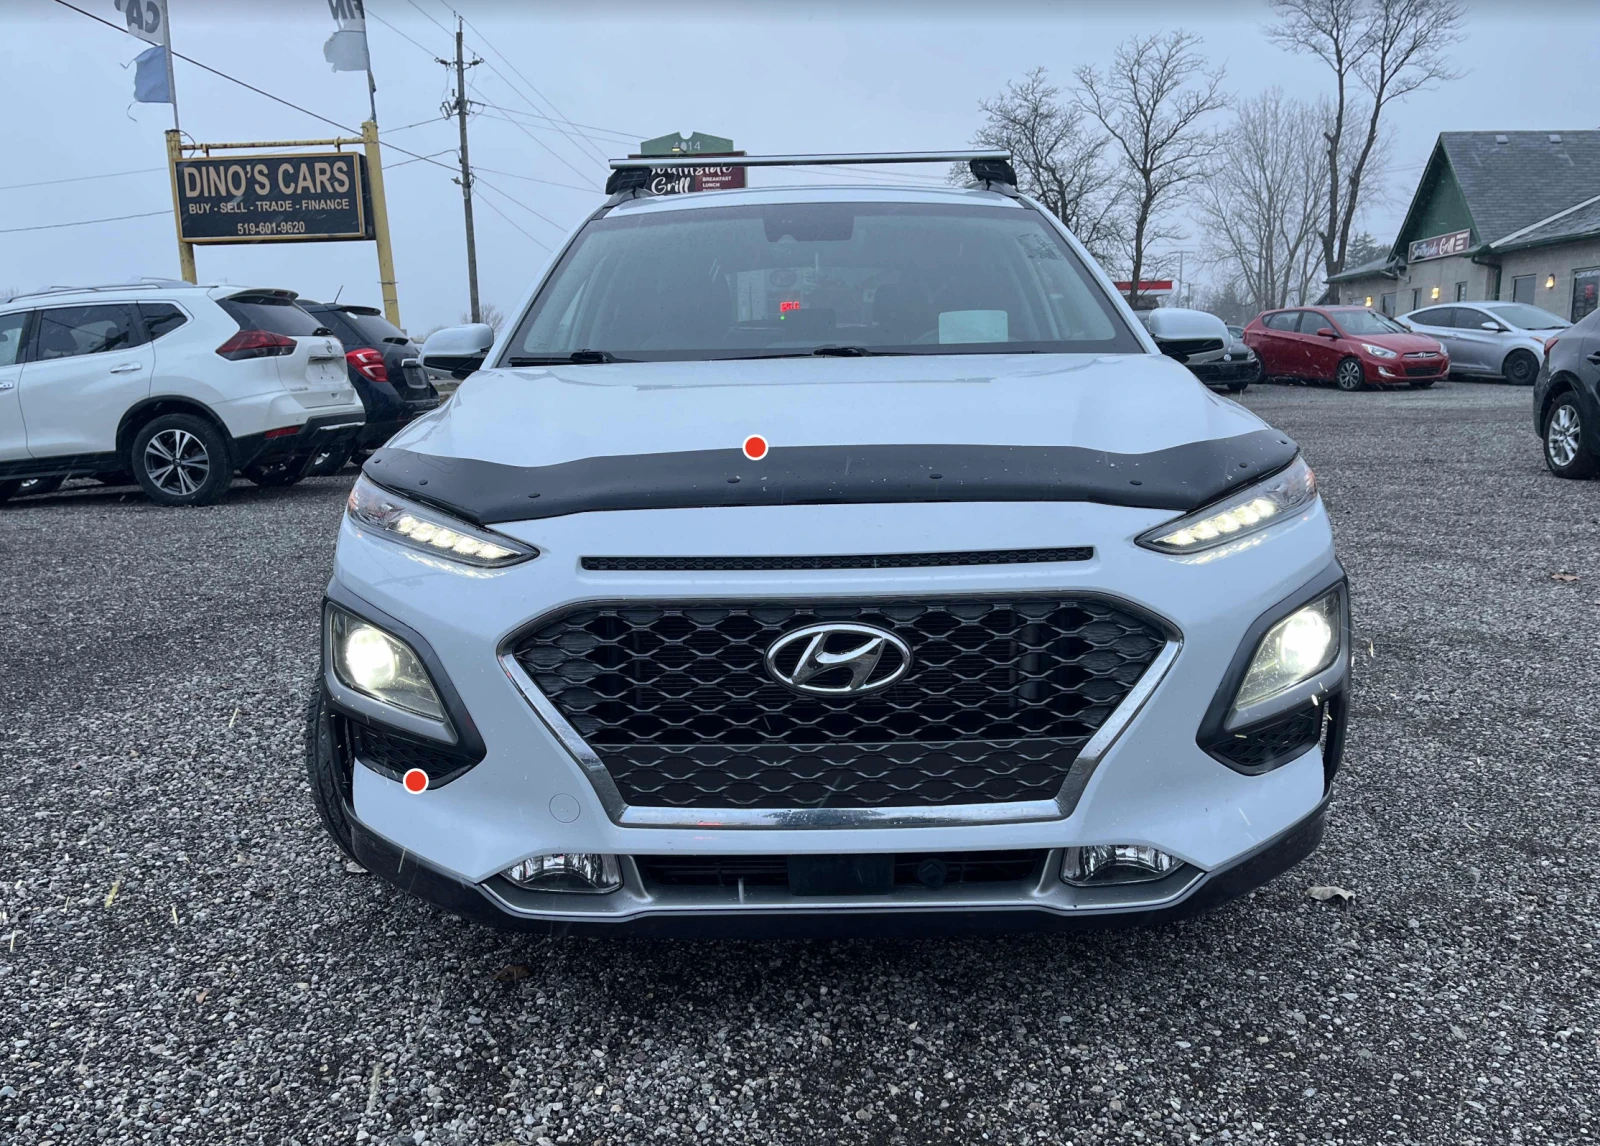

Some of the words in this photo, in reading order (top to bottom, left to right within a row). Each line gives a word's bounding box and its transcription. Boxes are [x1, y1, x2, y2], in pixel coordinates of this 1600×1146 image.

[183, 163, 271, 198] DINO'S
[277, 161, 350, 195] CARS
[651, 176, 691, 195] Grill
[188, 203, 211, 214] BUY
[219, 202, 248, 213] SELL
[255, 200, 293, 212] TRADE
[302, 199, 350, 210] FINANCE
[237, 221, 306, 235] 519-601-9620
